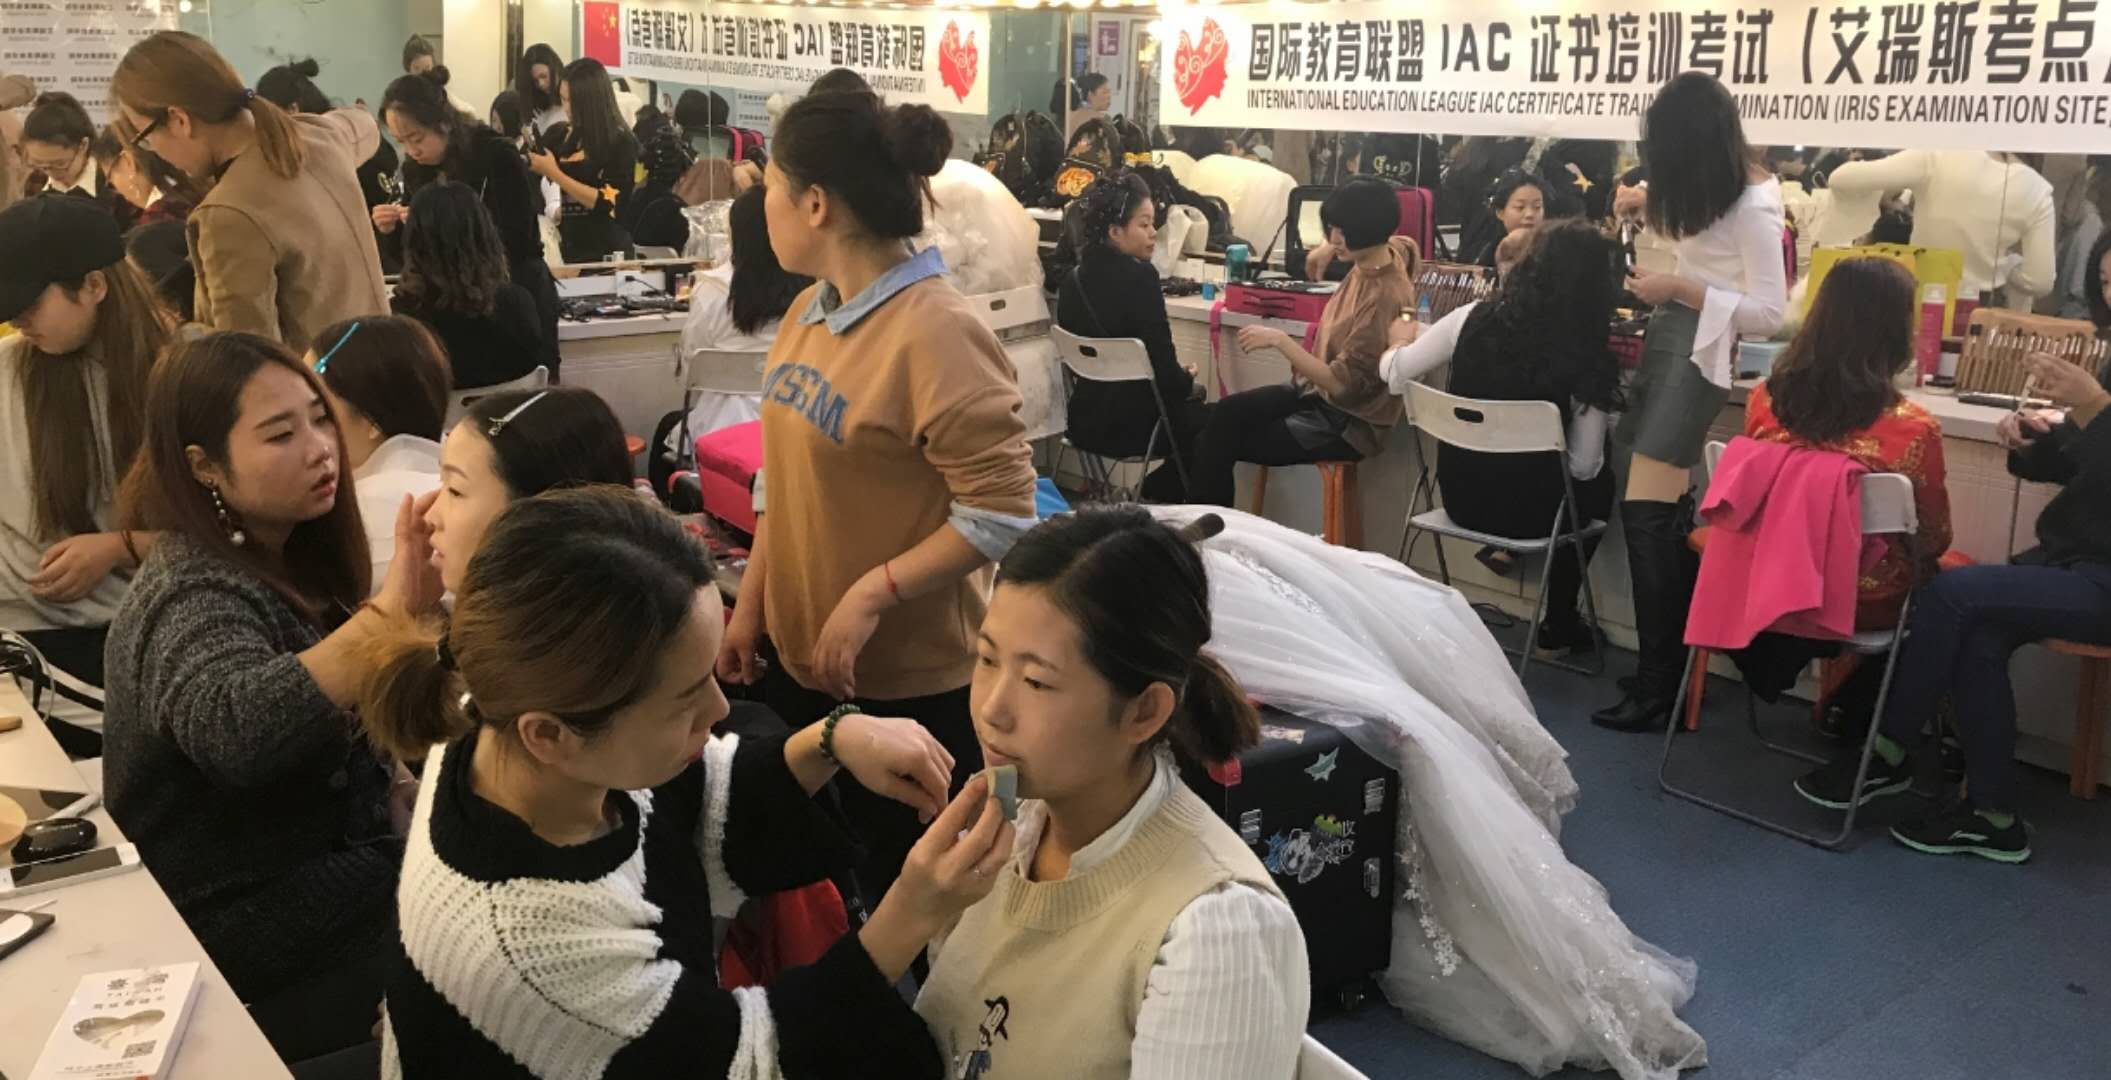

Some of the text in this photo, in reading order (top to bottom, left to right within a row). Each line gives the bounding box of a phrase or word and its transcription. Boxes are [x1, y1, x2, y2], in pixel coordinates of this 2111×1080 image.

[1247, 0, 2111, 85] 国际教育联盟 IAC 证书培训考试 （艾瑞斯考点
[1247, 89, 1340, 110] INTERNATIONAL
[1342, 89, 1419, 113] EDUCATION
[1421, 90, 1479, 113] LEAGUE
[1480, 91, 1504, 114] IAC
[1508, 92, 1604, 116] CERTIFICATE
[1736, 94, 1831, 121] MINATION
[1834, 95, 1880, 123] (IRIS
[1885, 95, 2051, 123] EXAMINATION
[2055, 94, 2111, 127] SITE
